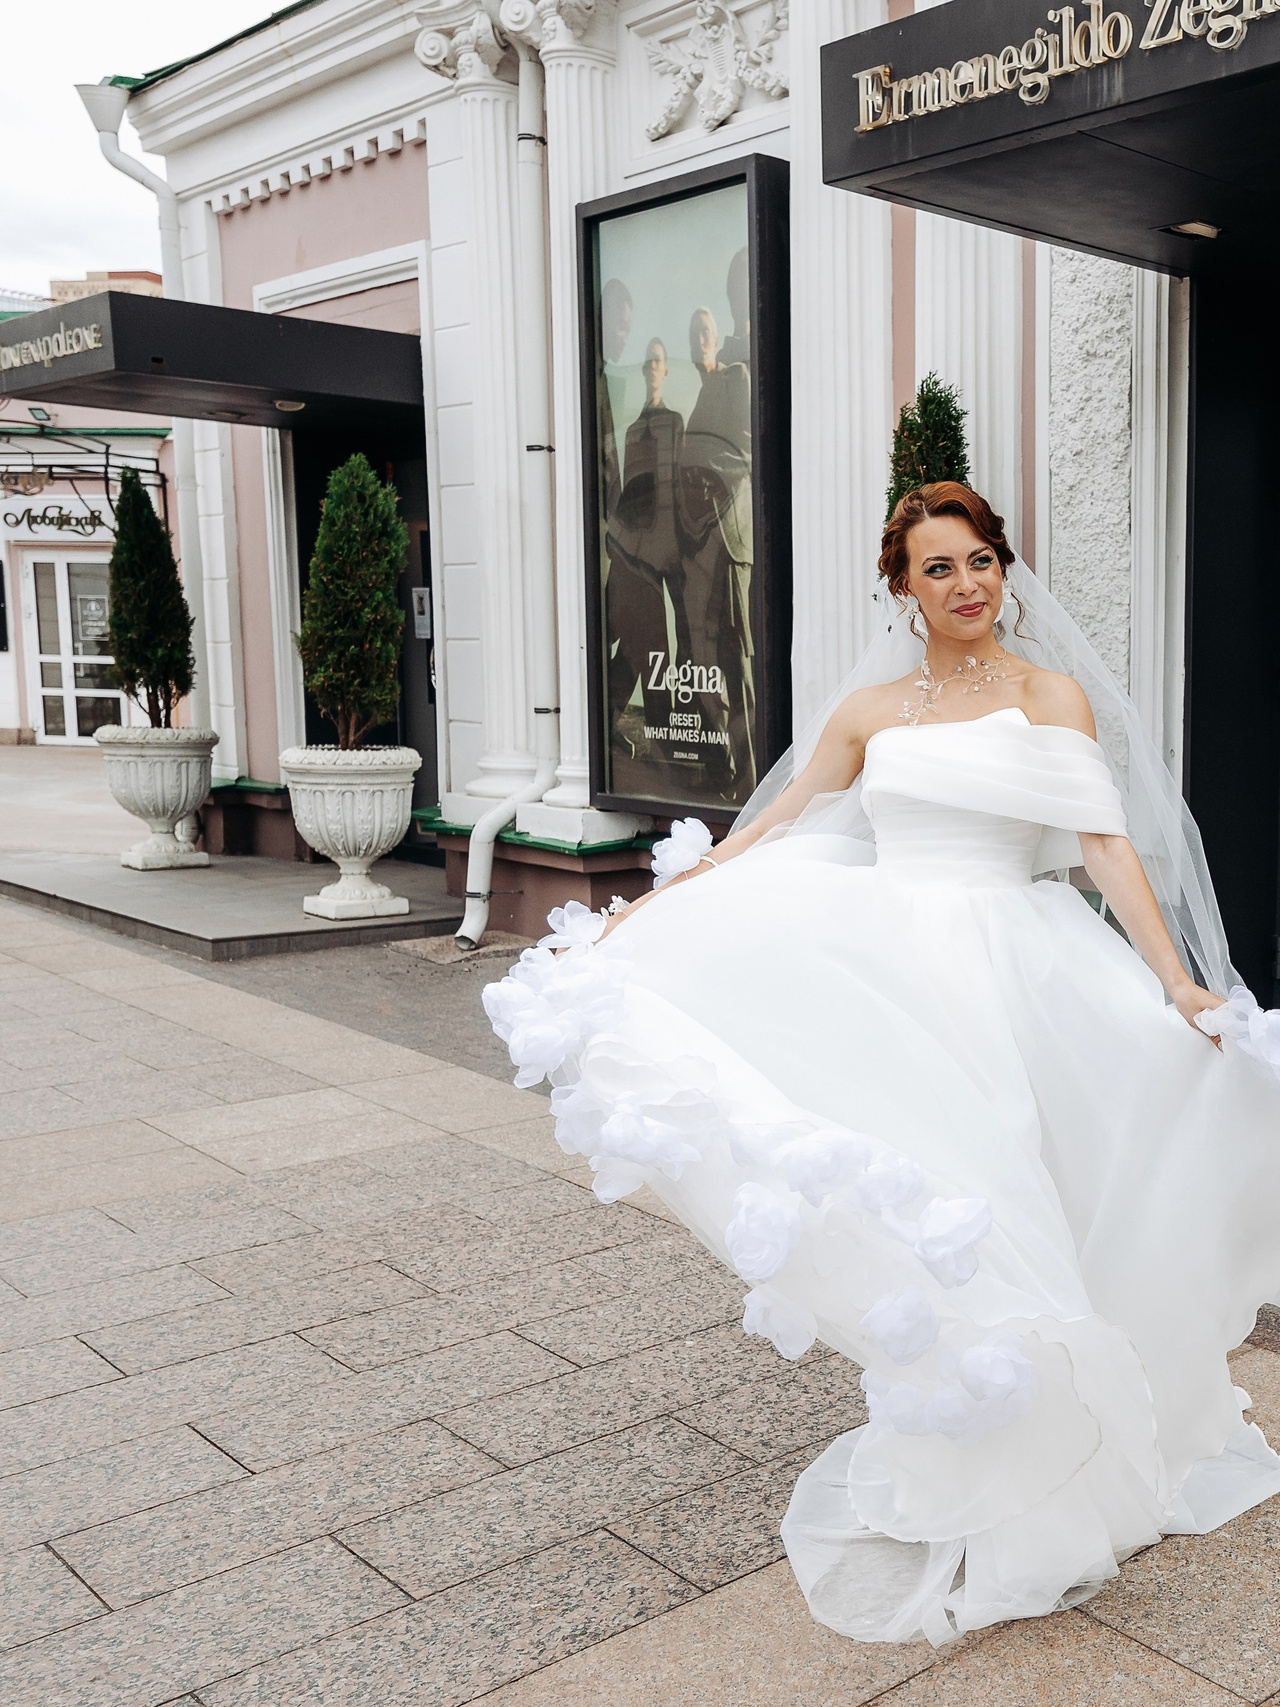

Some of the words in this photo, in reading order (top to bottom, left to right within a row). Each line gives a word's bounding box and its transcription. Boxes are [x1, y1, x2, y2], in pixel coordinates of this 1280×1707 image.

[853, 0, 1134, 133] Ermenegildo
[647, 651, 724, 703] Zegna
[644, 726, 668, 740] WHAT
[669, 728, 700, 743] MAKES
[700, 730, 707, 743] A
[708, 731, 730, 745] MAN
[669, 712, 702, 730] (RESET)
